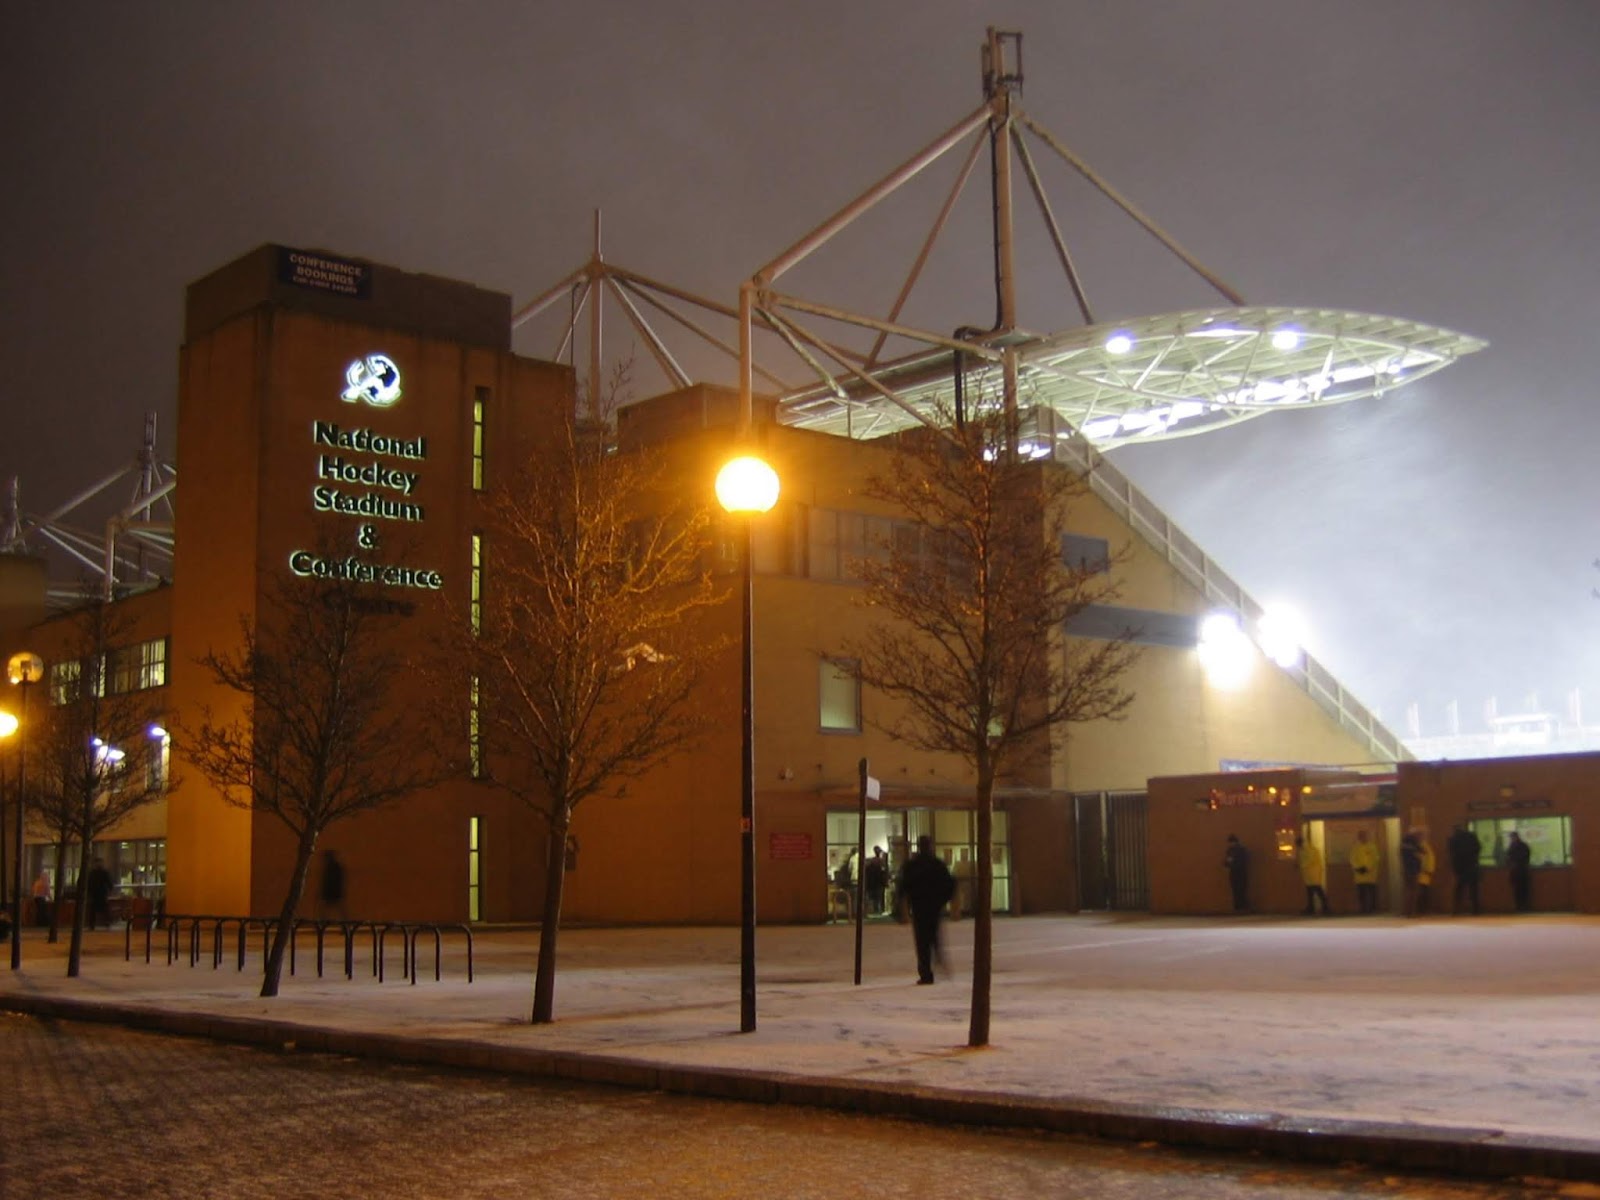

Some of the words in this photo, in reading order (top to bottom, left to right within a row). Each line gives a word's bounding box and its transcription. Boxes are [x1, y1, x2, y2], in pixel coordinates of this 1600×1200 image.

[289, 253, 363, 276] CONFERENCE
[296, 265, 355, 285] BOOKINGS
[313, 420, 426, 460] National
[318, 454, 419, 495] Hockey
[313, 485, 424, 522] Stadium
[358, 522, 378, 549] &
[289, 549, 442, 589] Conference
